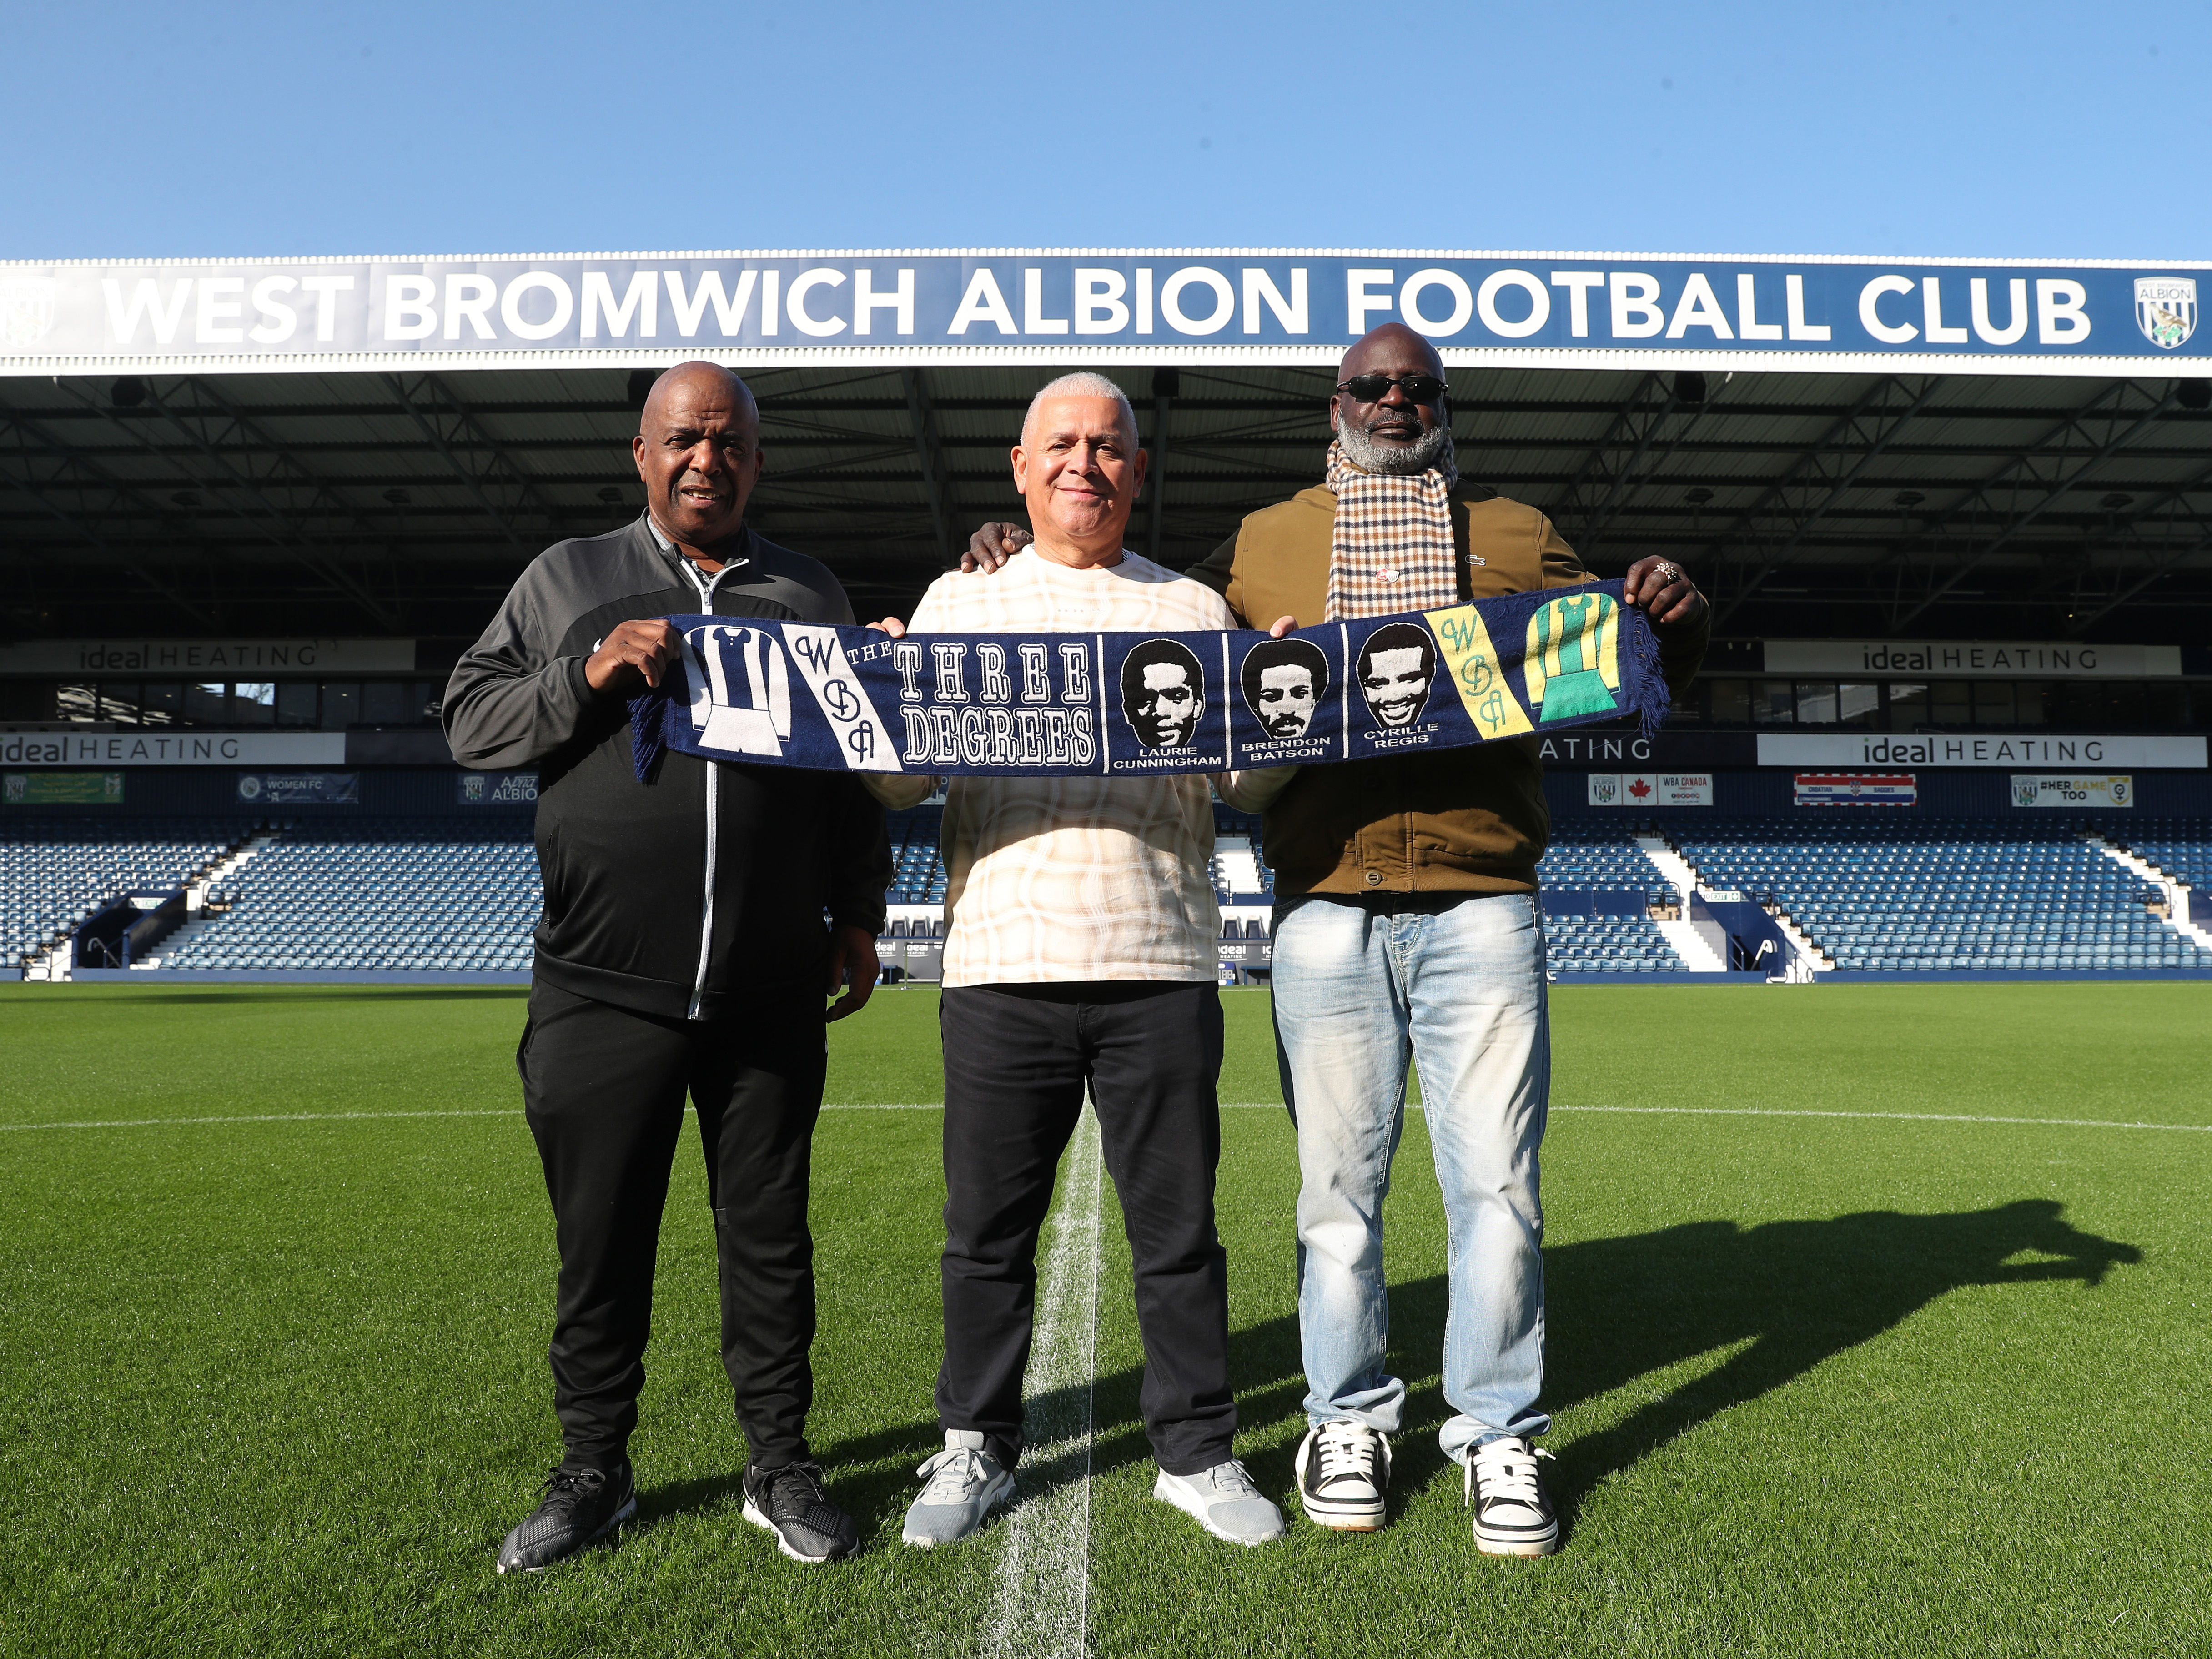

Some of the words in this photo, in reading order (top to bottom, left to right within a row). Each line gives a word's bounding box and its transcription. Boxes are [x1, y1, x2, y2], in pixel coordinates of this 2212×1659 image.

[2140, 289, 2191, 299] ALBION
[101, 275, 354, 344] WEST
[384, 268, 915, 340] BROMWICH
[947, 267, 1308, 335] ALBION
[1347, 268, 1831, 341] FOOTBALL
[1858, 275, 2091, 345] CLUB
[80, 644, 148, 669] ideal
[161, 646, 316, 666] HEATING
[1865, 645, 1932, 670] ideal
[1943, 649, 2097, 669] HEATING
[847, 640, 893, 664] THE
[894, 642, 1091, 704] THREE
[900, 705, 1096, 766] DEGREES
[1364, 723, 1438, 739] CYRILLE
[80, 739, 239, 759] HEATING
[1242, 737, 1331, 752] BRENDON
[1374, 734, 1429, 749] REGIS
[1539, 738, 1650, 759] ATING
[1139, 747, 1197, 757] LAURIE
[1250, 747, 1324, 762] BATSON
[1865, 738, 1934, 763] ideal
[1946, 741, 2103, 761] HEATING
[1113, 757, 1222, 769] CUNNINGHAM
[267, 781, 306, 789] WOMEN
[309, 781, 322, 789] FC
[1663, 777, 1679, 786] WBA
[1681, 777, 1707, 786] CANADA
[2041, 781, 2071, 790] #HER
[2073, 781, 2106, 790] GAME
[492, 788, 538, 800] ALBIO
[2062, 791, 2086, 799] TOO
[875, 941, 895, 951] deal
